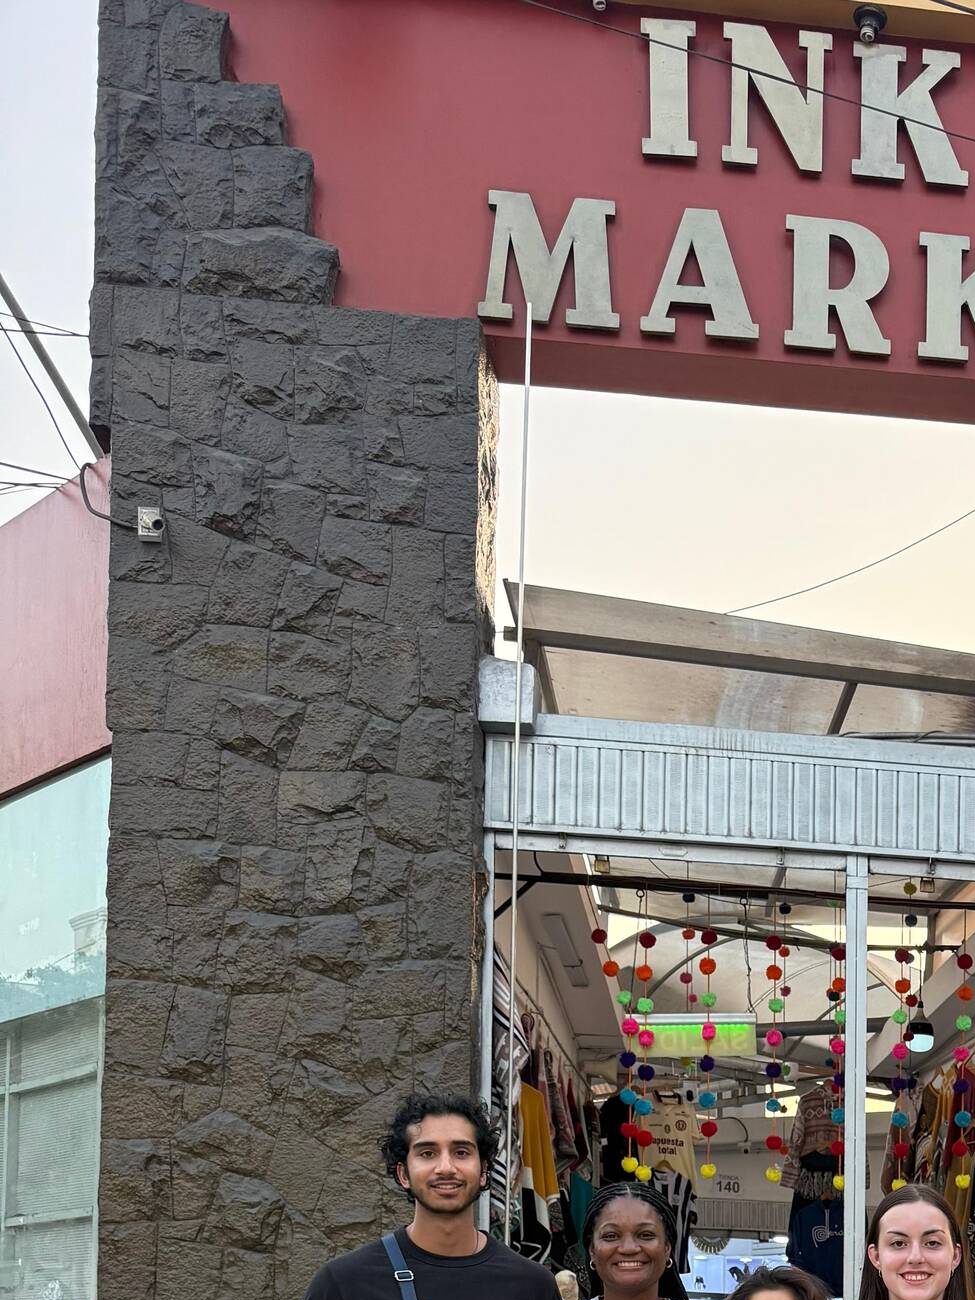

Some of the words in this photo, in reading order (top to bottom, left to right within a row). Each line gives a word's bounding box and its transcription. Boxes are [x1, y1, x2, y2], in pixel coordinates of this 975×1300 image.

[652, 1138, 684, 1147] apuesta
[658, 1146, 677, 1155] total
[716, 1181, 740, 1193] 140
